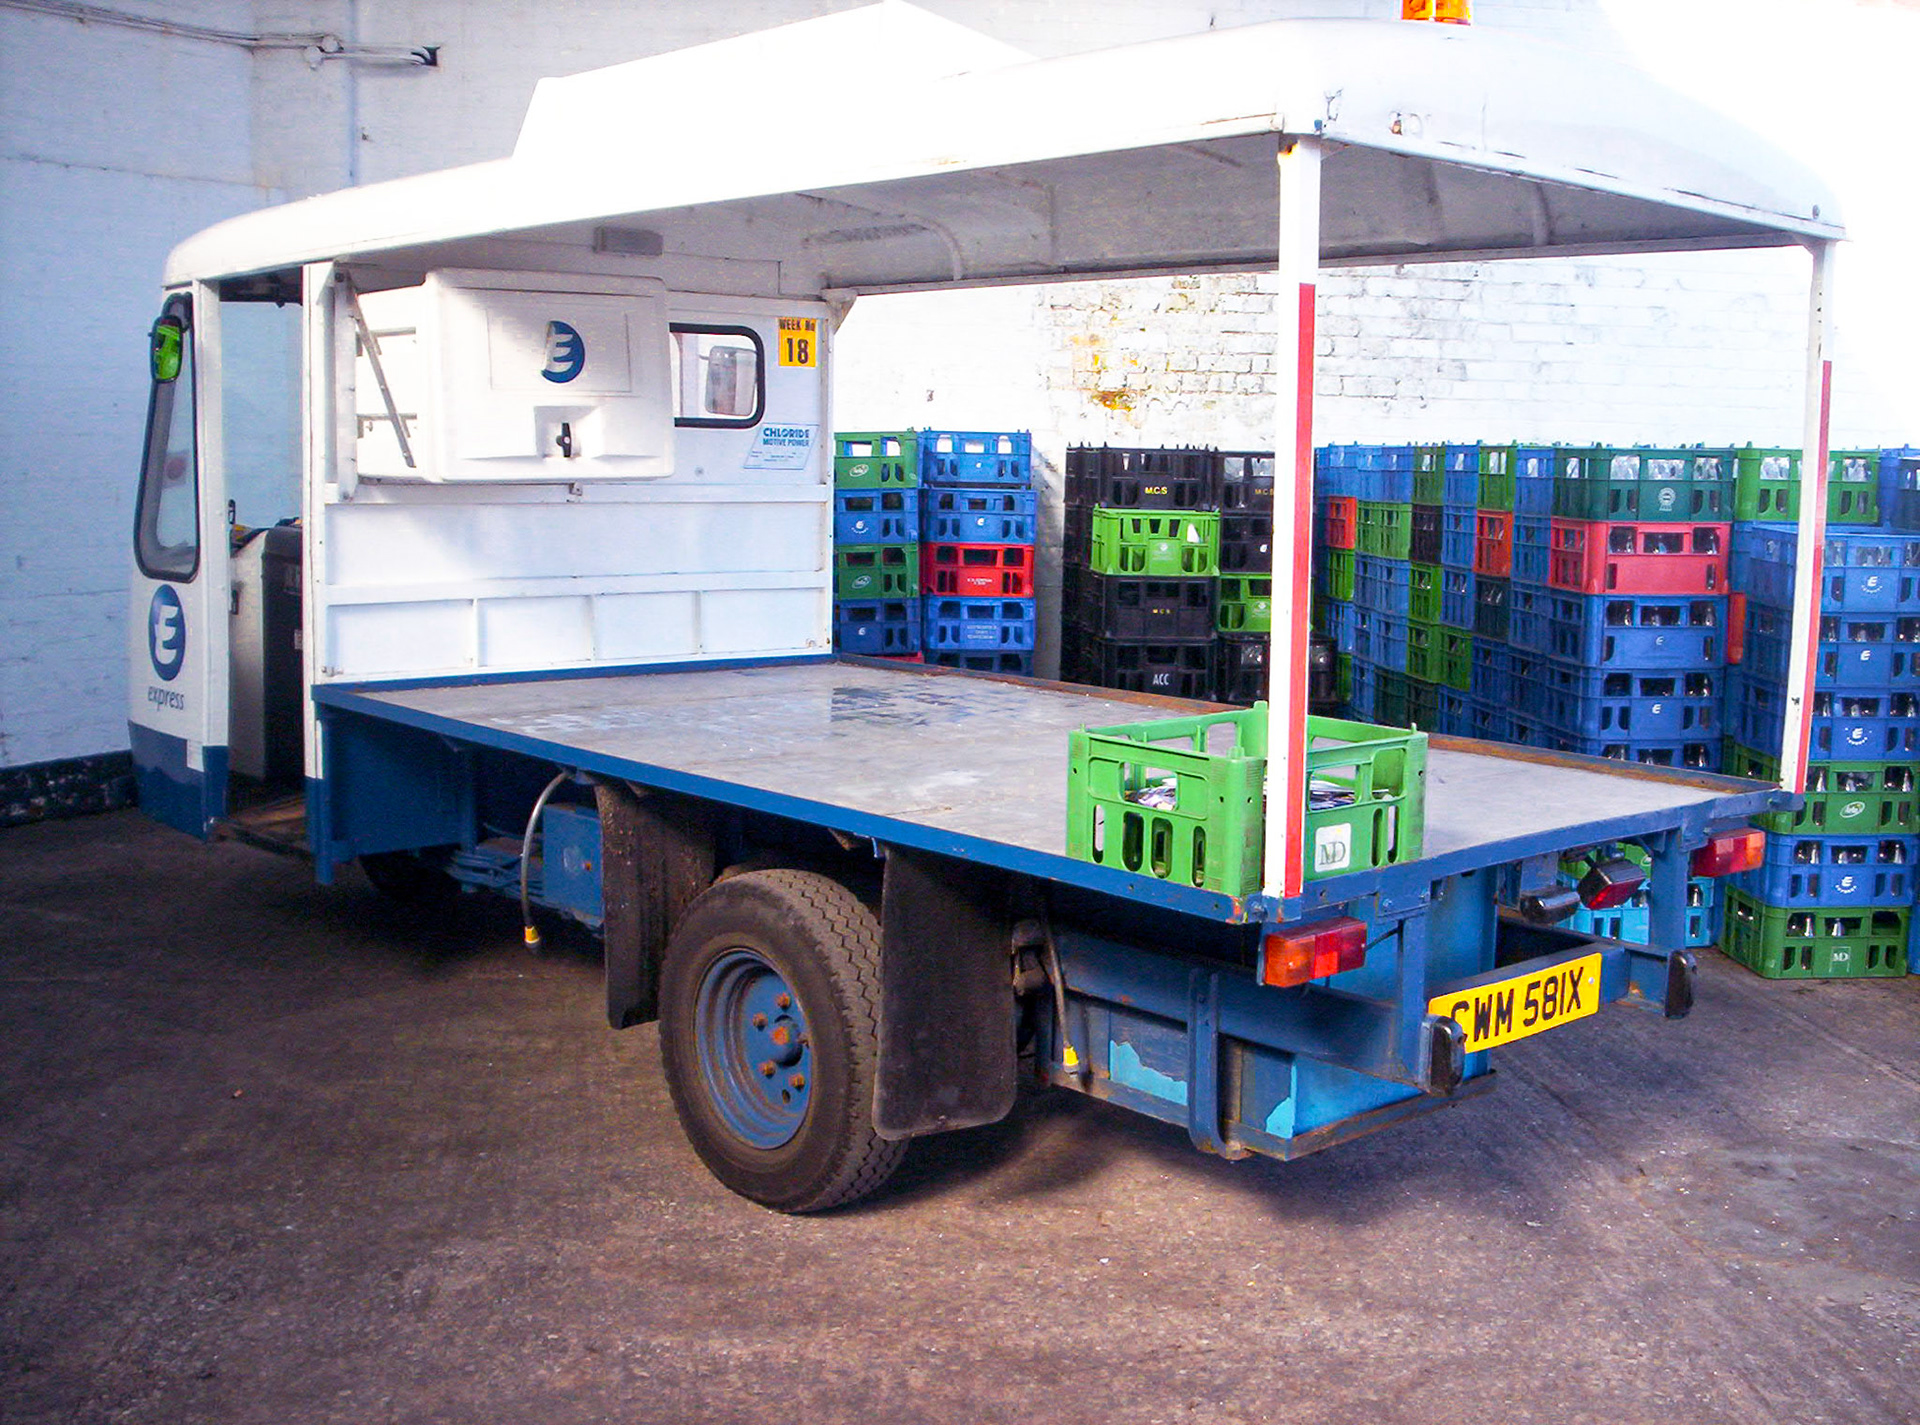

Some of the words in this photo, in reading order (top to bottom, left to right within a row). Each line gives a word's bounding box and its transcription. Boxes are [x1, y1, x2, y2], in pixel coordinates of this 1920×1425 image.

[779, 318, 800, 330] WEEK
[787, 337, 808, 364] 18
[763, 427, 809, 438] CHLORIDE
[762, 438, 786, 446] MOTIVE
[788, 439, 809, 447] POWER
[1152, 673, 1170, 686] ACC
[147, 686, 184, 711] express
